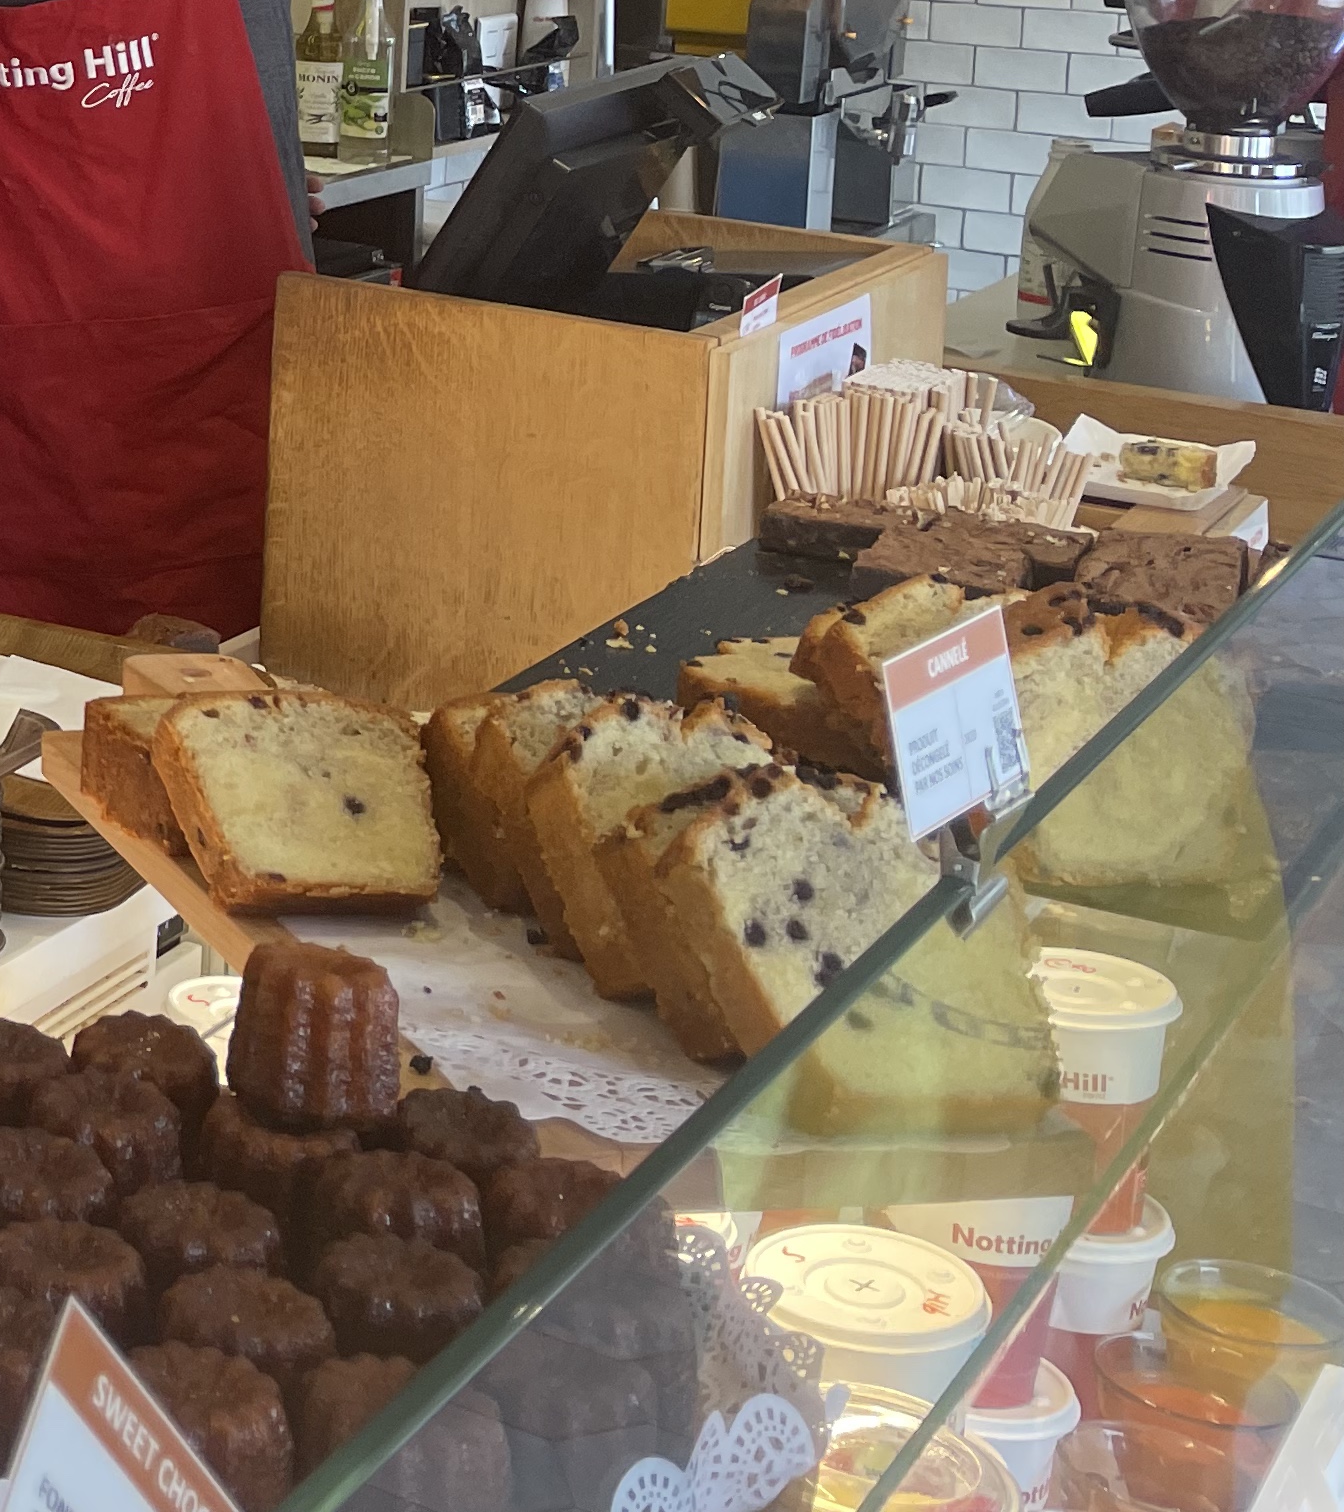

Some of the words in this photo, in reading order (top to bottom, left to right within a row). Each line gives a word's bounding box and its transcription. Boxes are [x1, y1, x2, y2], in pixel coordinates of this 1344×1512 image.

[84, 33, 154, 79] Hill
[80, 73, 154, 109] Coffee
[927, 636, 969, 678] CANNELÉ
[1062, 1071, 1106, 1092] Hill
[952, 1222, 1052, 1257] Notting
[93, 1376, 159, 1472] SWEET
